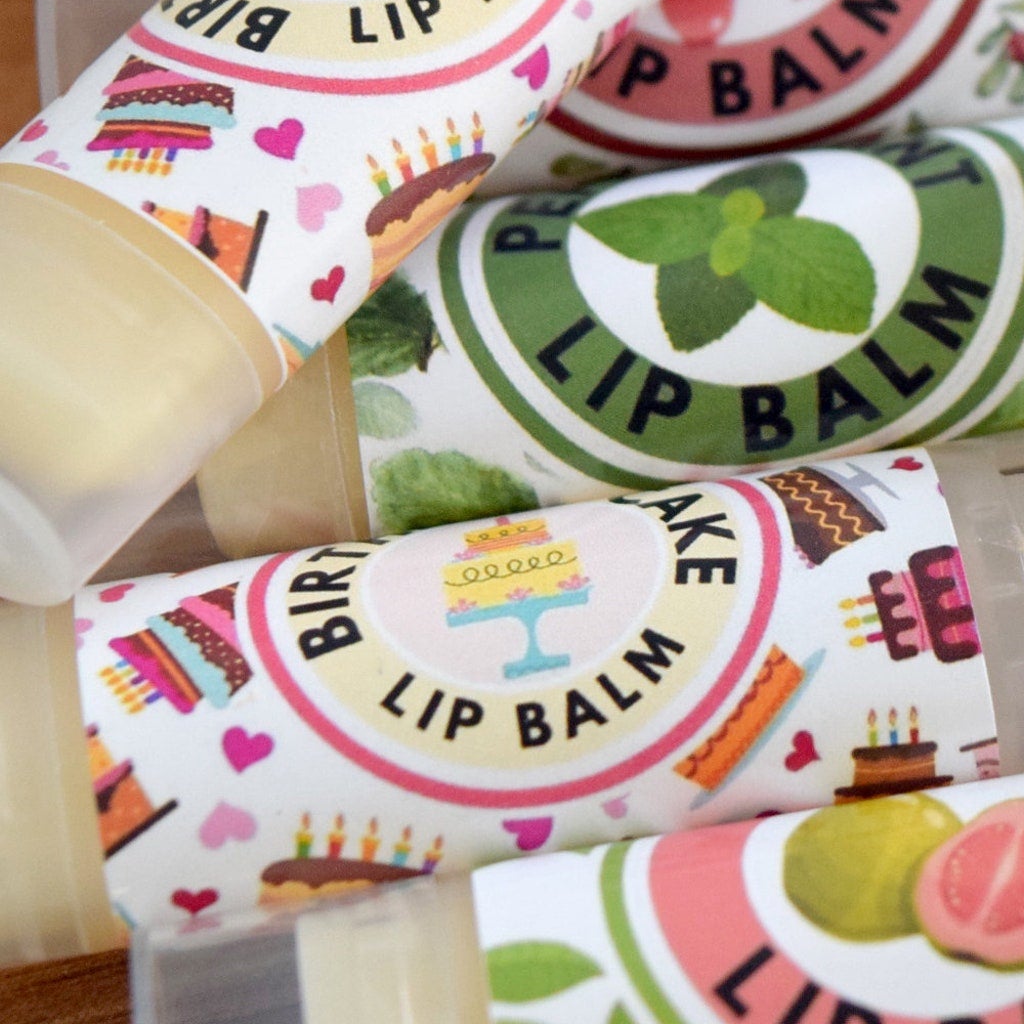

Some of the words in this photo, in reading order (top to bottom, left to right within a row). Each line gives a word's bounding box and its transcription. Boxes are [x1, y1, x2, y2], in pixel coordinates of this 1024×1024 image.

[536, 316, 693, 435] LIP
[740, 264, 992, 454] BALM
[287, 540, 386, 661] BIRT
[381, 672, 485, 741] LIP
[516, 628, 686, 749] BALM
